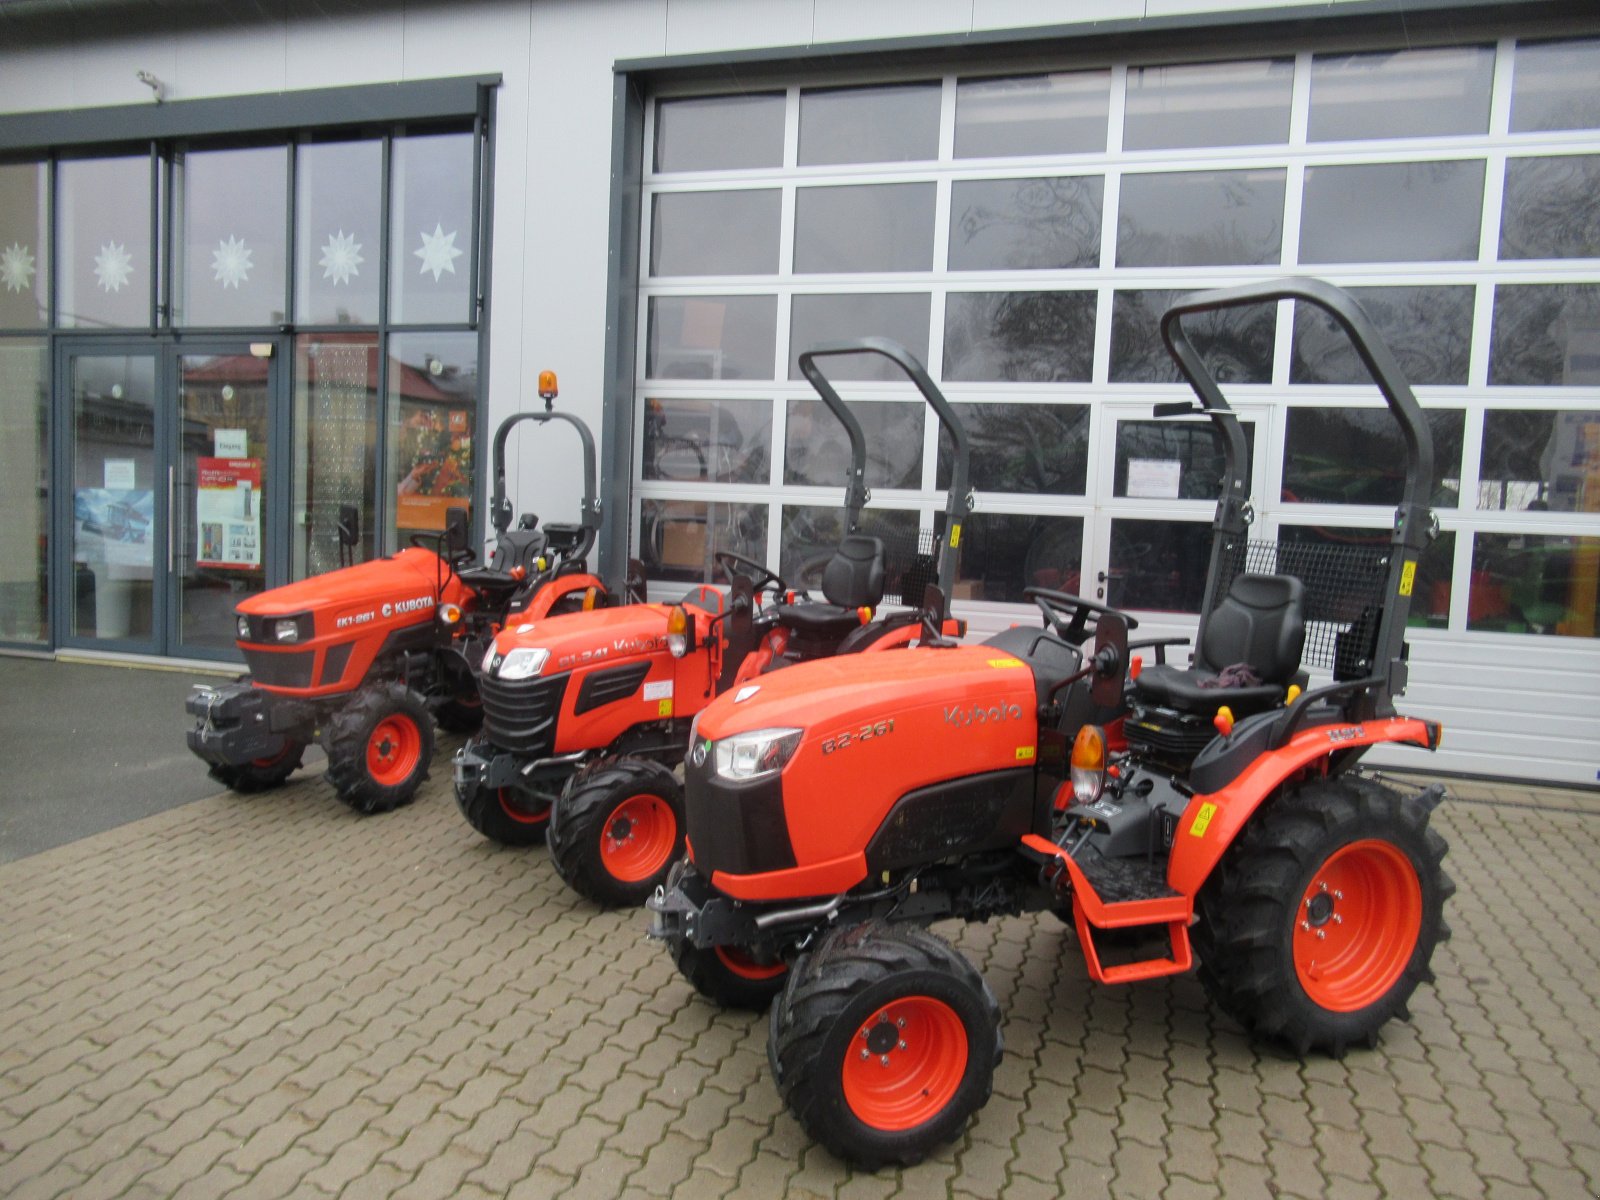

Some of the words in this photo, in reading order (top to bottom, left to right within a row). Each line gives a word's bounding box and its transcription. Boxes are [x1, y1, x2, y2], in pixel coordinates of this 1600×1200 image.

[394, 595, 434, 614] KUBOTA
[943, 699, 1022, 728] Kubota
[821, 718, 895, 756] B2-261
